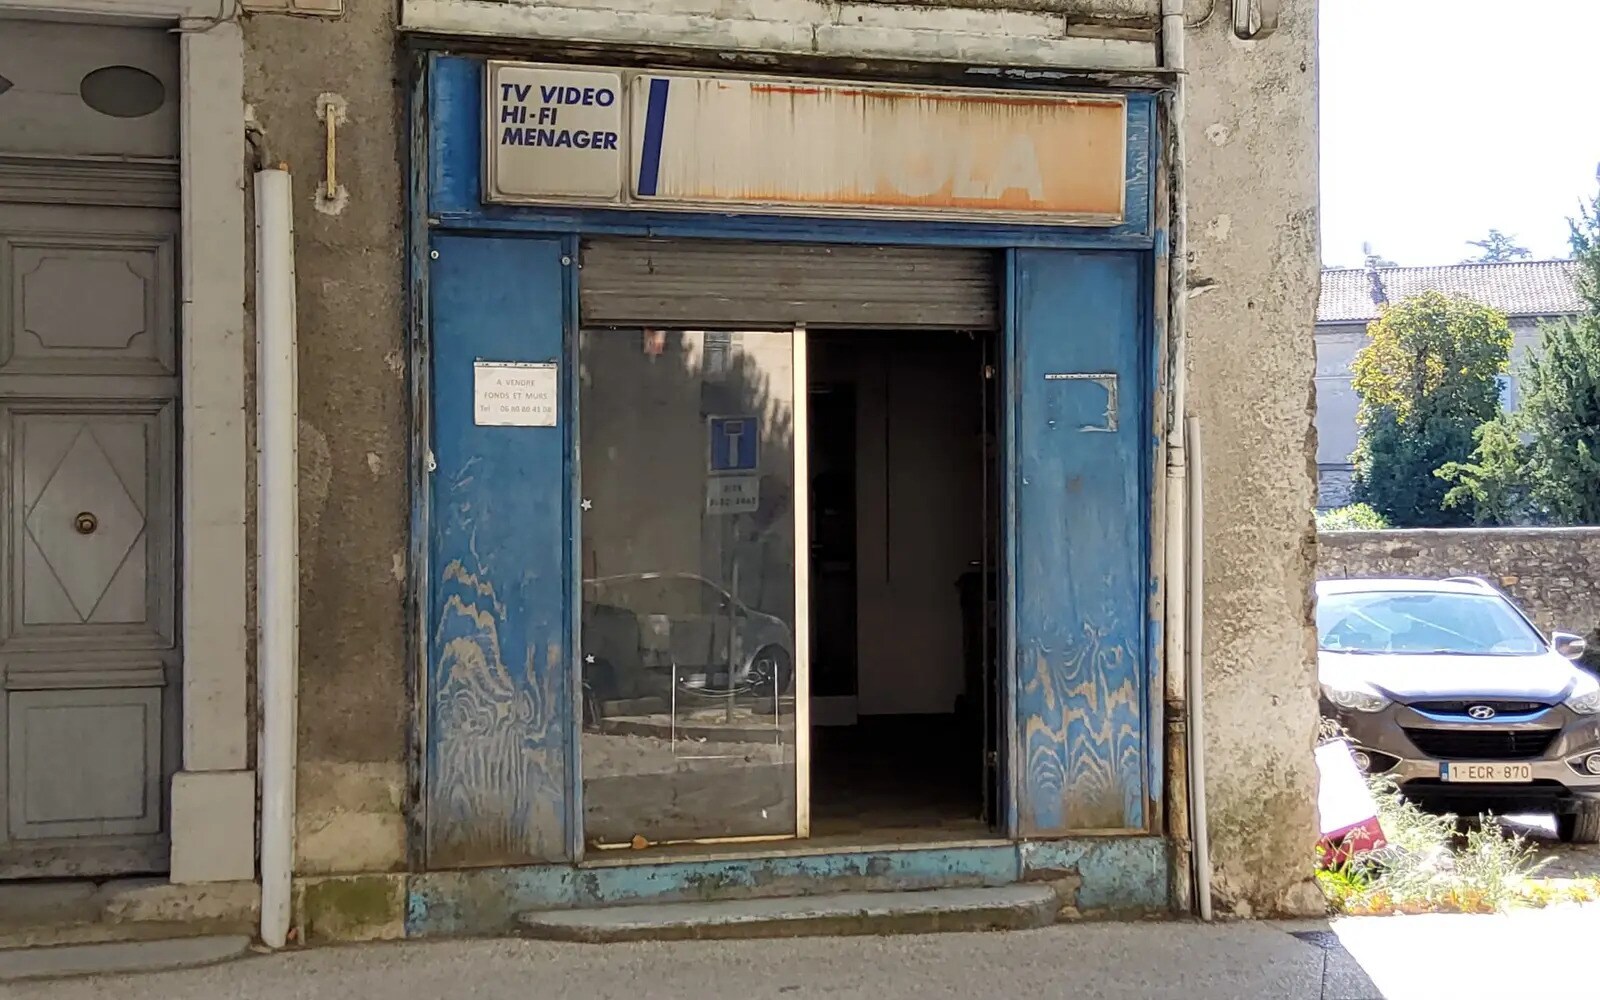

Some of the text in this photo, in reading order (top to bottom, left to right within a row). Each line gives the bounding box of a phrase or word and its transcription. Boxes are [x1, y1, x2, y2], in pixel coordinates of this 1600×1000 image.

[501, 83, 614, 107] TV VIDEO
[501, 127, 618, 150] MENAGER
[506, 379, 536, 387] VENDRE
[525, 392, 548, 400] MURS
[1452, 766, 1530, 779] 1-ECR-870
